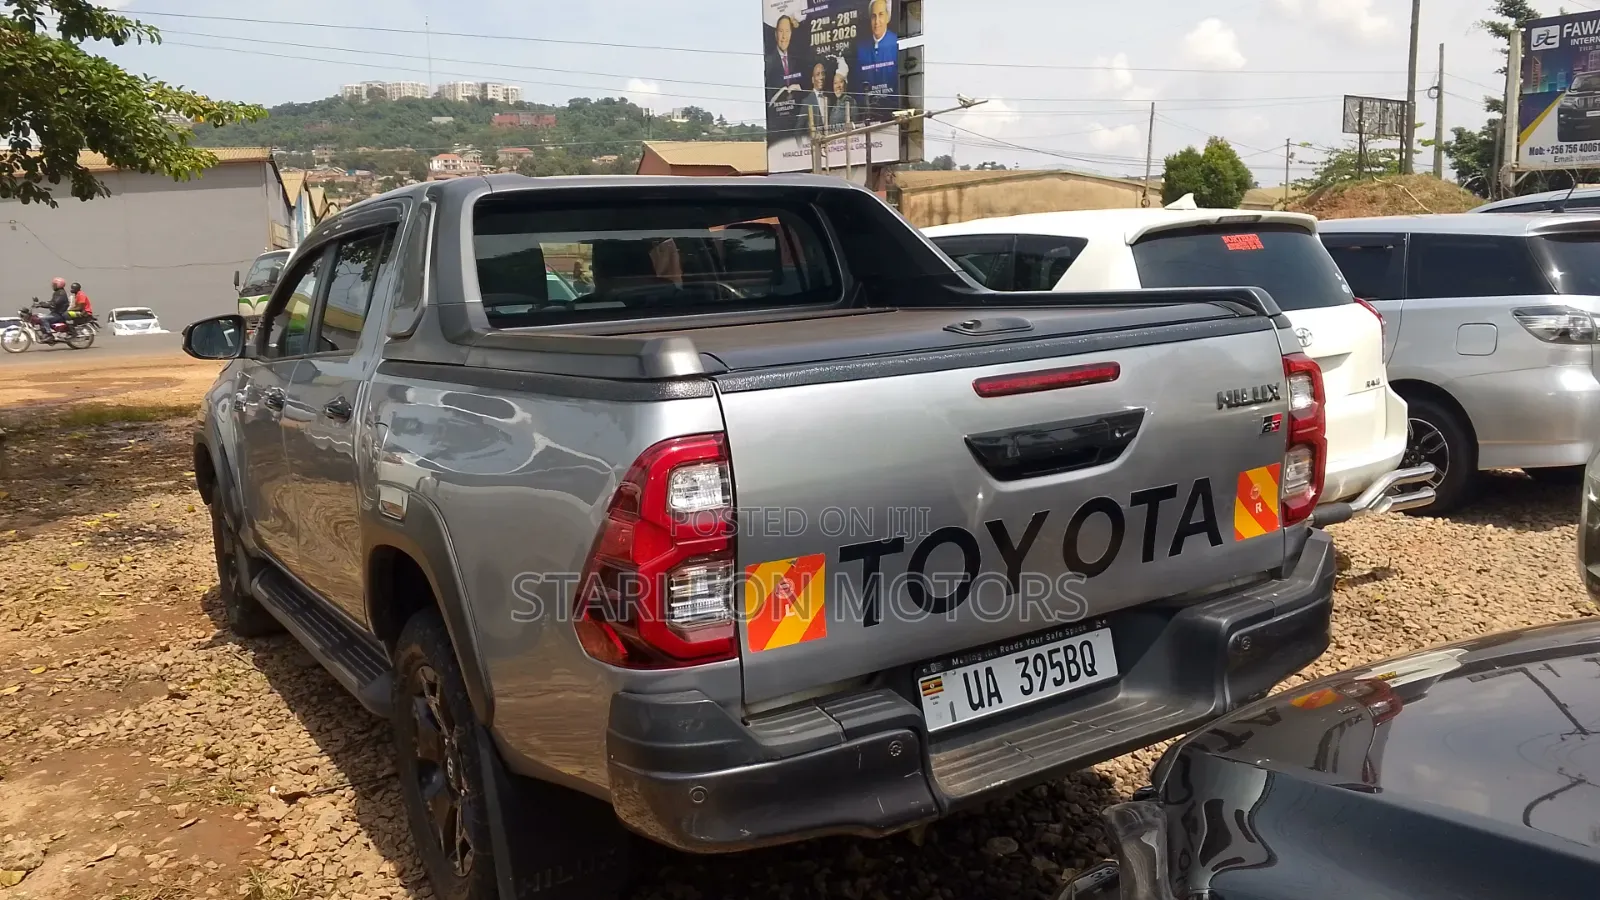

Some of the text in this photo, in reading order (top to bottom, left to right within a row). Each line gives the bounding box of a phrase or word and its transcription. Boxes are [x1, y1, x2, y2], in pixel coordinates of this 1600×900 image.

[810, 17, 830, 33] 22ND
[837, 10, 858, 27] 28TH
[810, 25, 857, 46] JUNE 2026
[816, 46, 831, 55] 9AM
[835, 42, 850, 51] 9PM
[1546, 145, 1564, 154] +256
[1565, 144, 1578, 153] 756
[1217, 382, 1281, 410] HILUX
[1255, 502, 1263, 514] R
[838, 476, 1224, 628] TOYOTA
[785, 604, 796, 617] L
[999, 641, 1024, 654] Roads
[1025, 636, 1044, 646] Your
[1045, 631, 1063, 642] Safe
[1065, 625, 1088, 636] Space
[963, 639, 1098, 711] UA 395BQ
